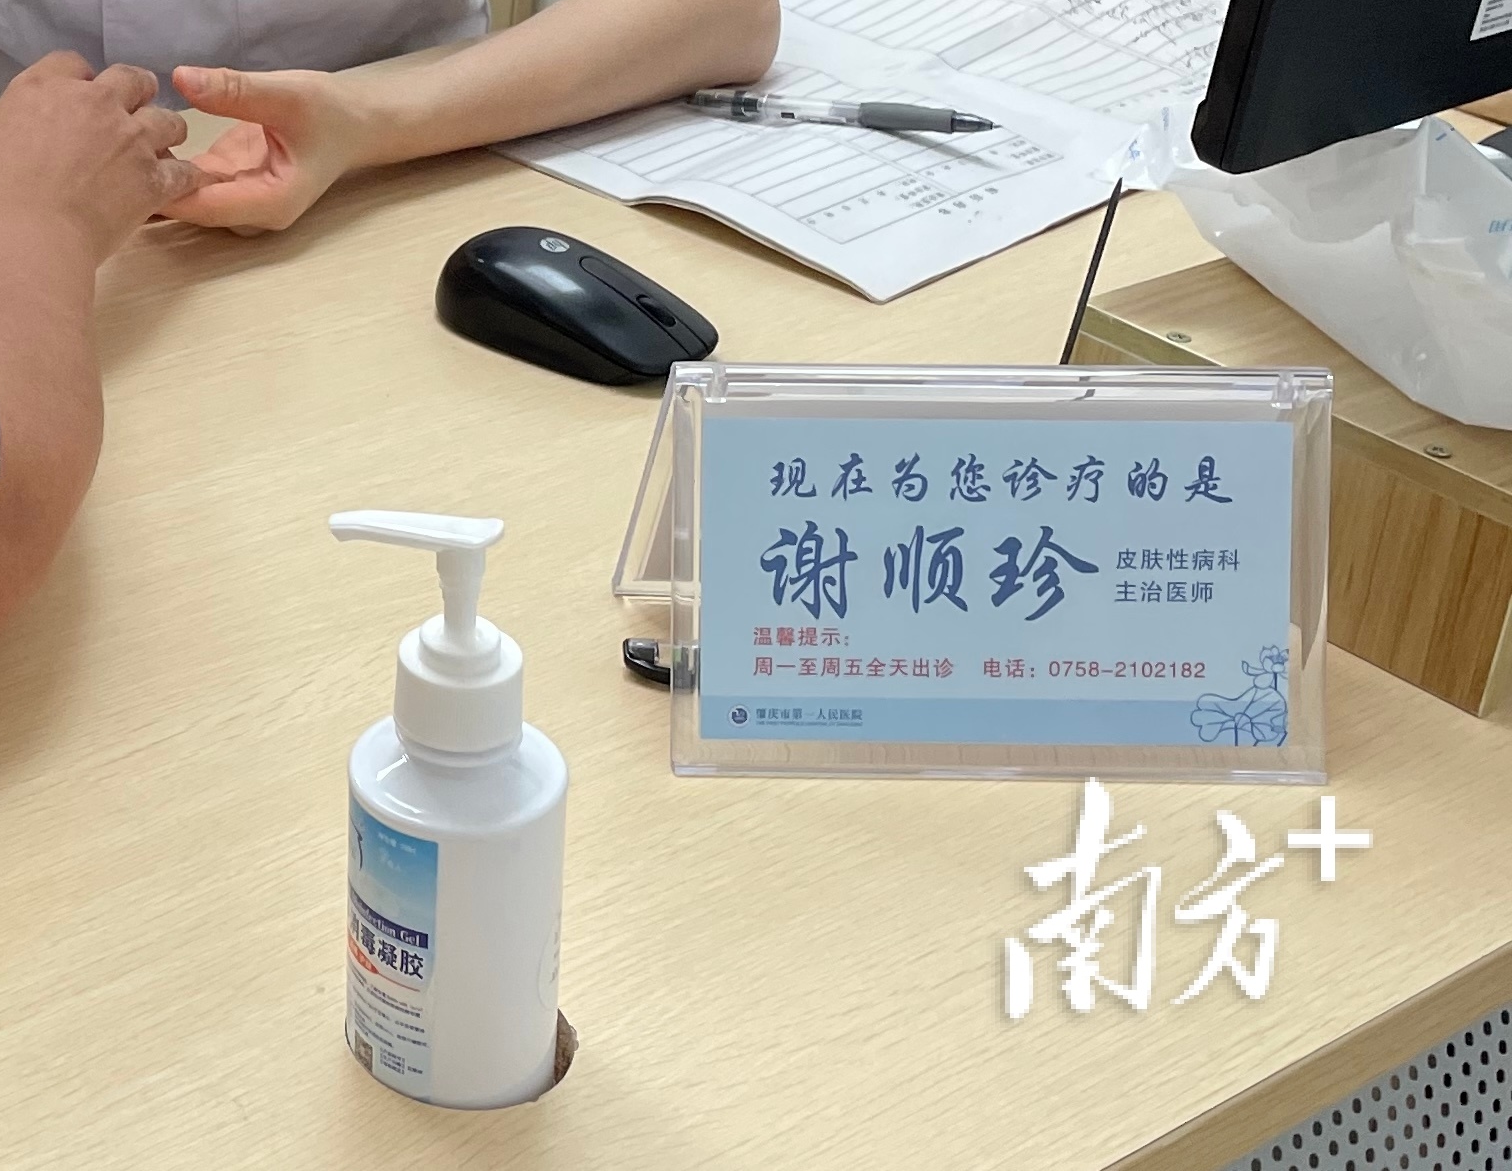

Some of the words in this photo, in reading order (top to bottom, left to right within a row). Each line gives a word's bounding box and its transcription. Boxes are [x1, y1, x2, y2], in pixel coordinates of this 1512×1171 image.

[769, 452, 1234, 504] 现在为您诊疗的是
[759, 520, 1099, 622] 谢顺珍
[1115, 547, 1241, 574] 皮肤性病科
[1114, 579, 1215, 605] 主治医师
[752, 656, 955, 680] 周一至周五全天出诊
